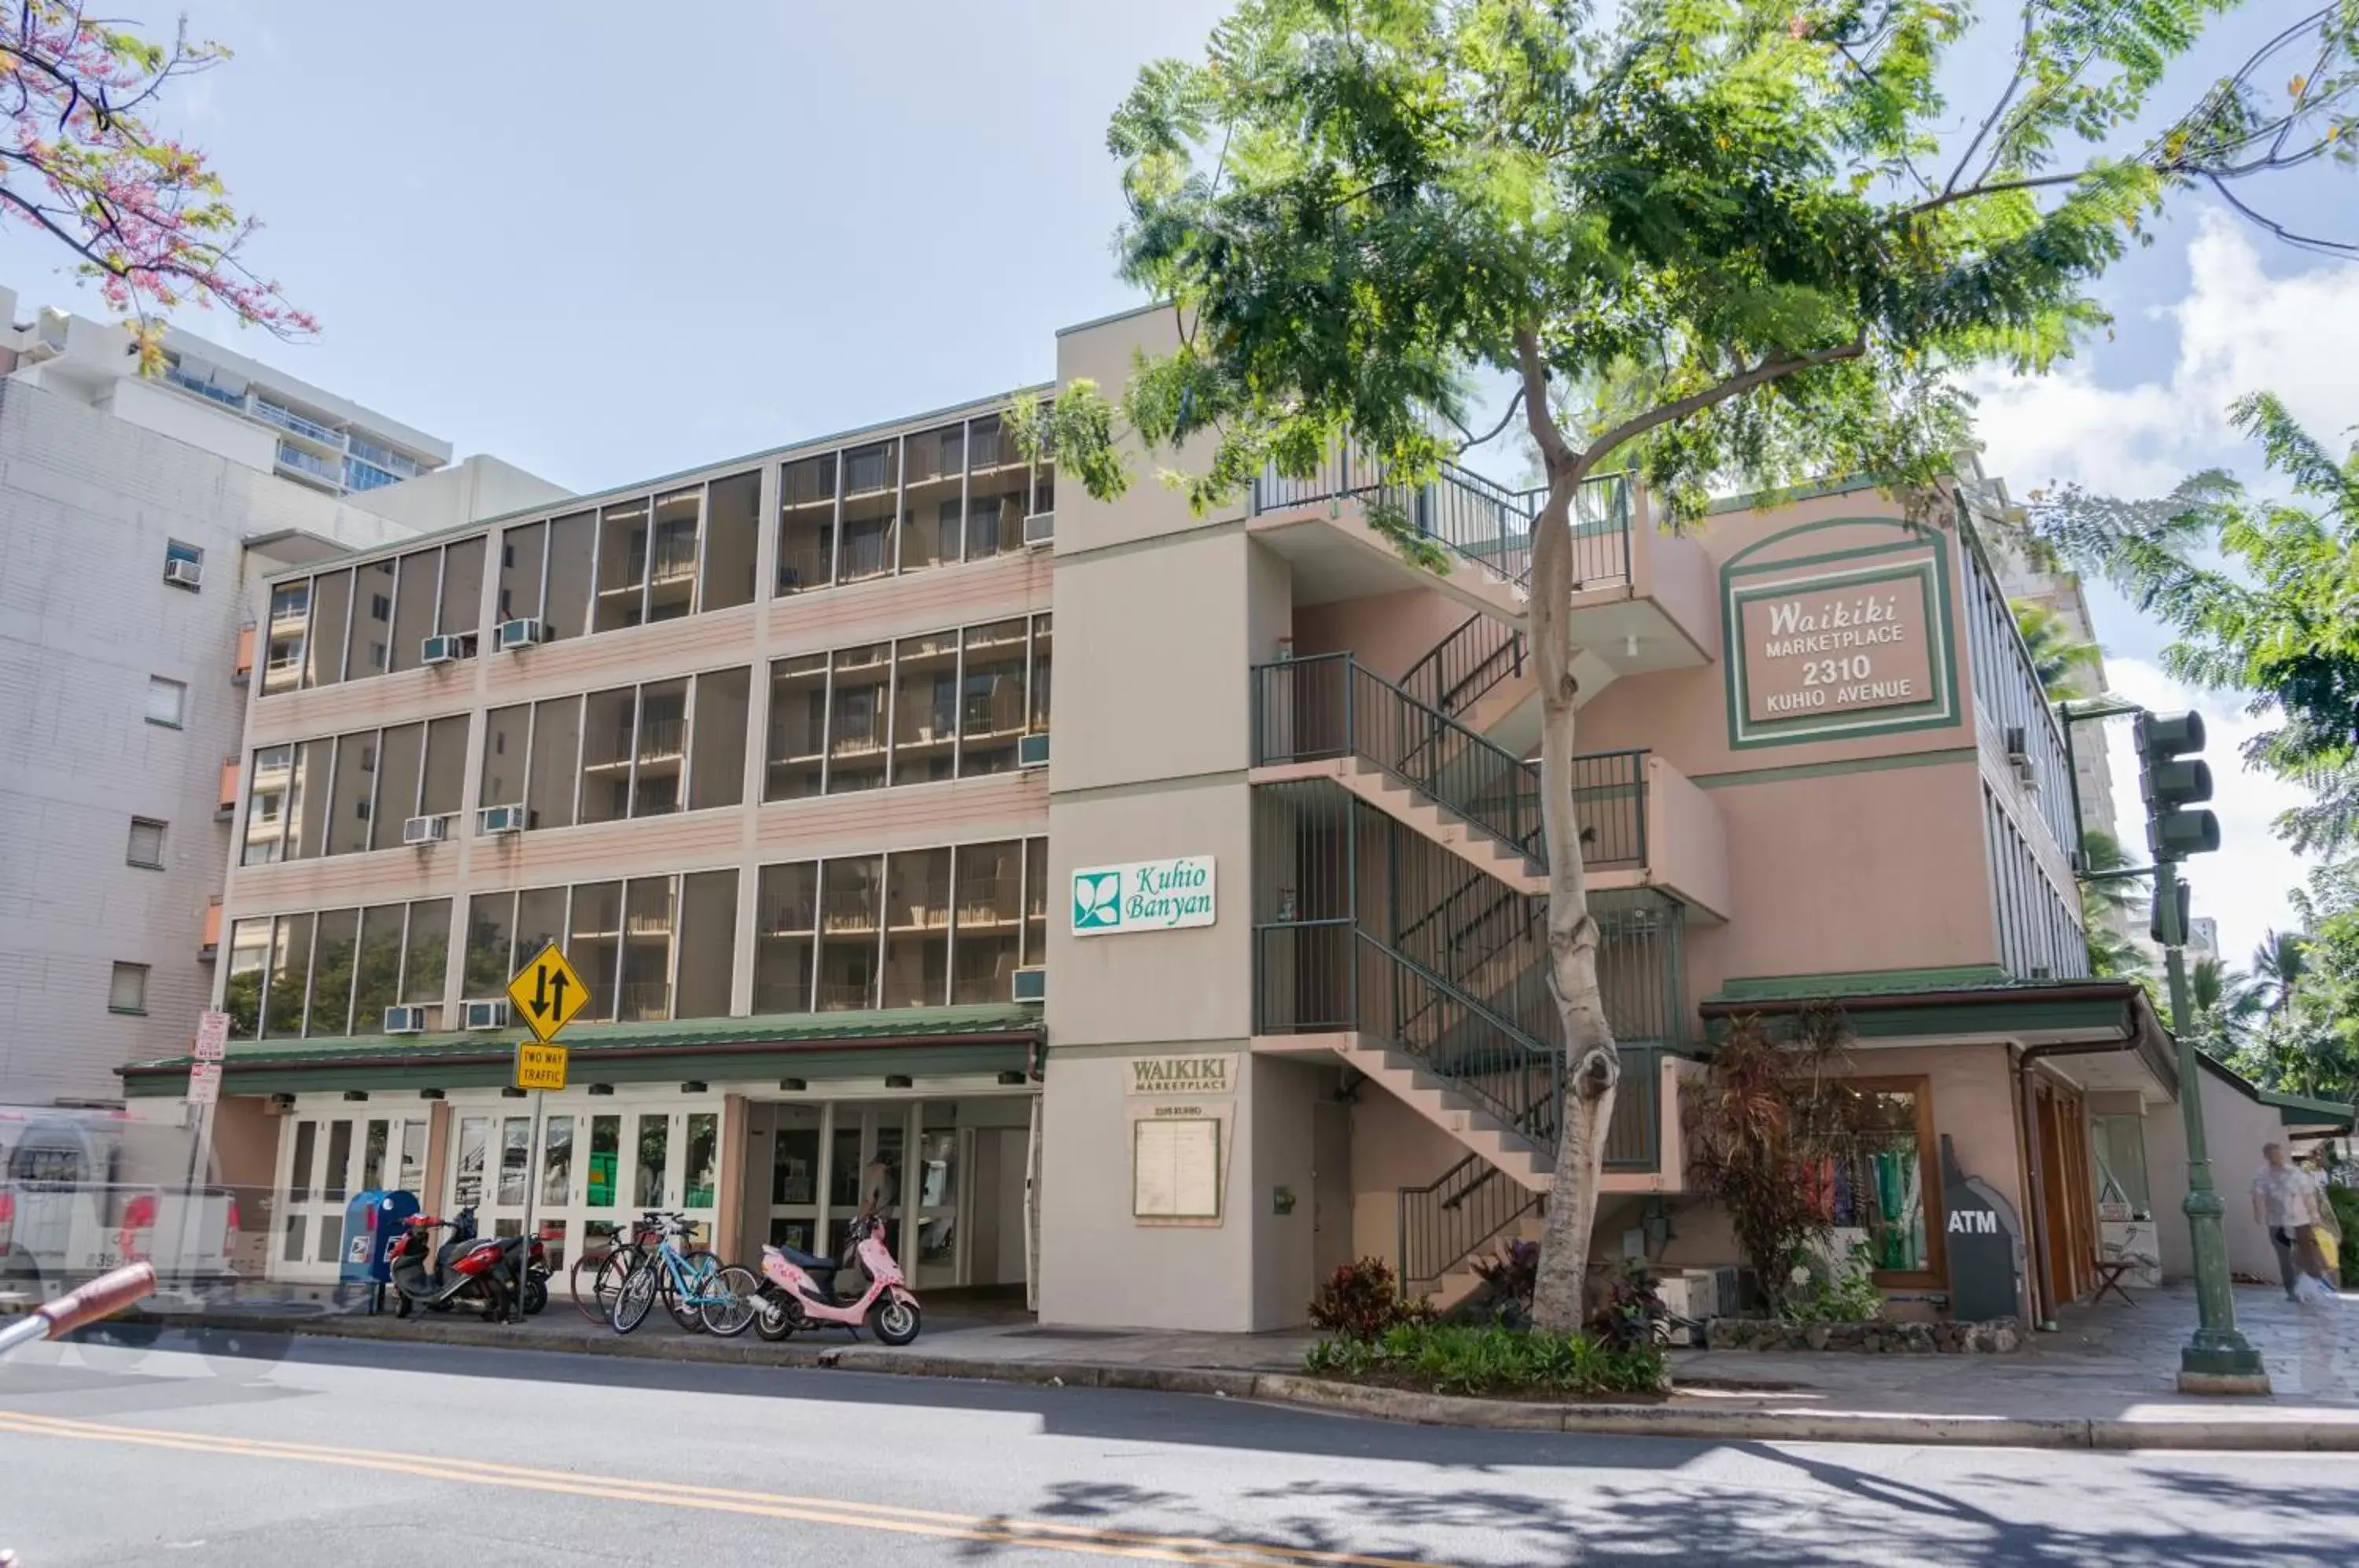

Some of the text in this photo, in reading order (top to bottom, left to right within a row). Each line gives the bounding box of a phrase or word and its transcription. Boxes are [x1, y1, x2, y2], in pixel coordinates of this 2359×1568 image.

[1769, 595, 1897, 635] Waikiki
[1766, 624, 1904, 657] MARKETPLACE
[1802, 654, 1871, 686] 2310
[1767, 679, 1912, 712] KUHIO AVENUE
[1137, 860, 1206, 895] Kuhio
[1126, 893, 1211, 926] Banyan
[524, 1051, 563, 1064] TWO WAY
[1132, 1058, 1225, 1080] WAIKIKI
[524, 1069, 561, 1082] TRAFFIC
[1135, 1080, 1227, 1091] MARKETPLACE
[1948, 1210, 1997, 1233] ATM
